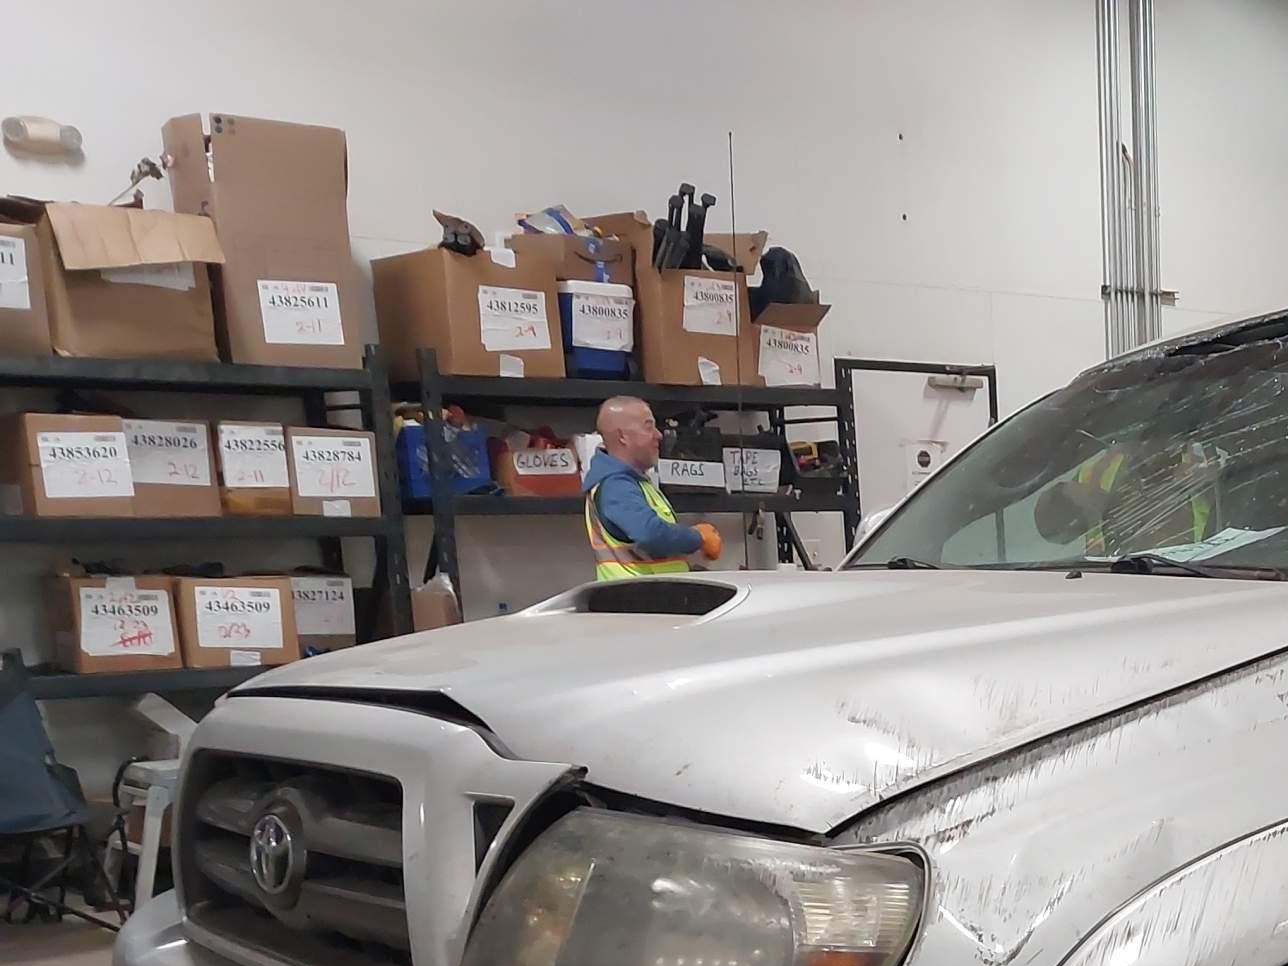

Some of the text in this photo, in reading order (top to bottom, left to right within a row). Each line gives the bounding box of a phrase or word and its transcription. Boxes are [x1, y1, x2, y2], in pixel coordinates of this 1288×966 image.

[269, 294, 329, 308] 43825611
[694, 290, 733, 304] 43800835
[487, 300, 538, 314] 43812595
[579, 304, 629, 319] 43800835
[766, 338, 810, 355] 43800835
[131, 434, 198, 449] 43828026
[224, 439, 285, 451] 43822556
[49, 446, 117, 460] 43853620
[303, 450, 362, 463] 43828784
[517, 453, 569, 468] GLOVES
[671, 462, 704, 476] RAGS
[91, 604, 158, 617] 43463509
[206, 600, 271, 613] 43463509
